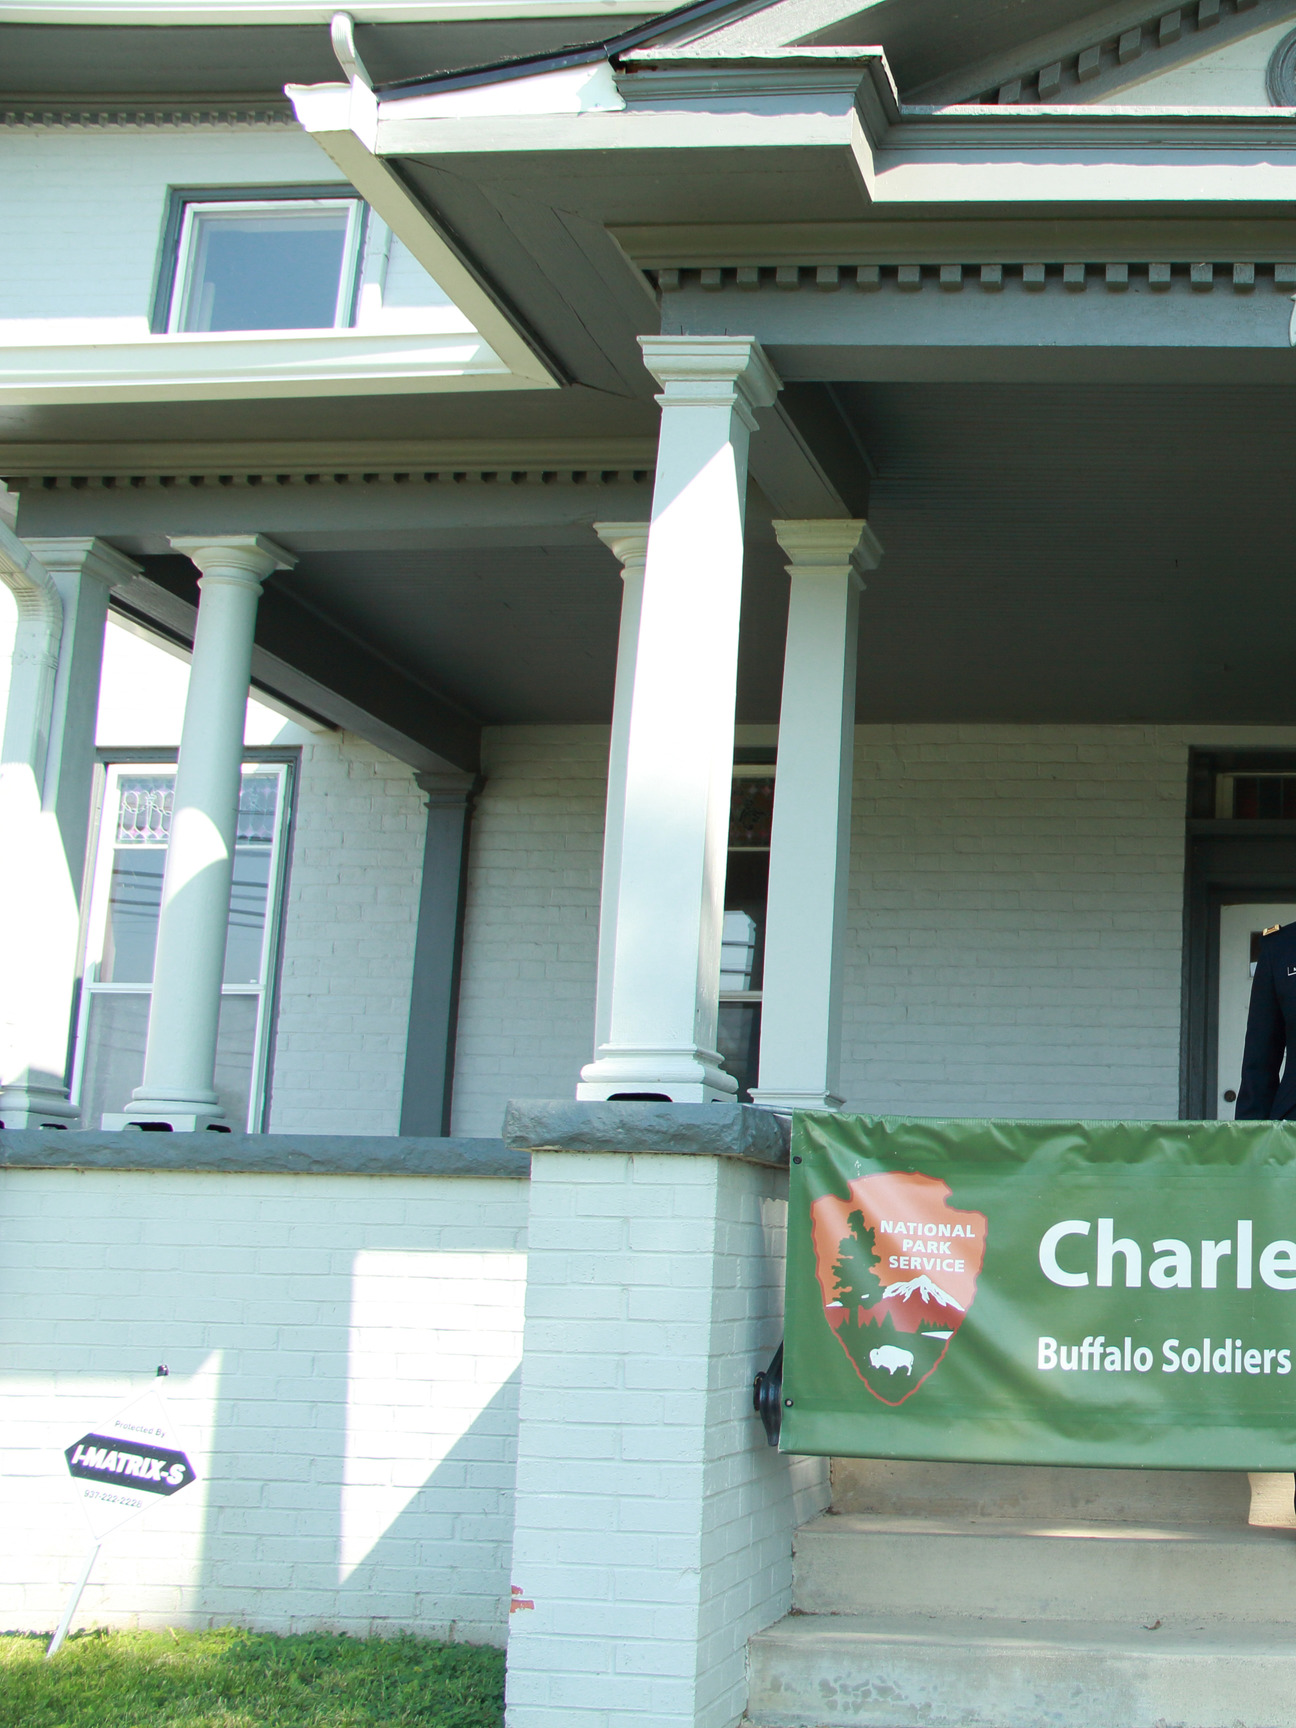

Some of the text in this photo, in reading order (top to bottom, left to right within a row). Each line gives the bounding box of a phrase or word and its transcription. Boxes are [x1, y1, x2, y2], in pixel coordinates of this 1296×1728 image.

[880, 1220, 976, 1238] NATIONAL
[902, 1239, 952, 1254] PARK
[889, 1256, 965, 1272] SERVICE
[1037, 1336, 1154, 1372] Buffalo
[1161, 1337, 1292, 1374] Soldiers
[114, 1420, 165, 1438] Protected By
[71, 1444, 186, 1485] I-MATRIX-S
